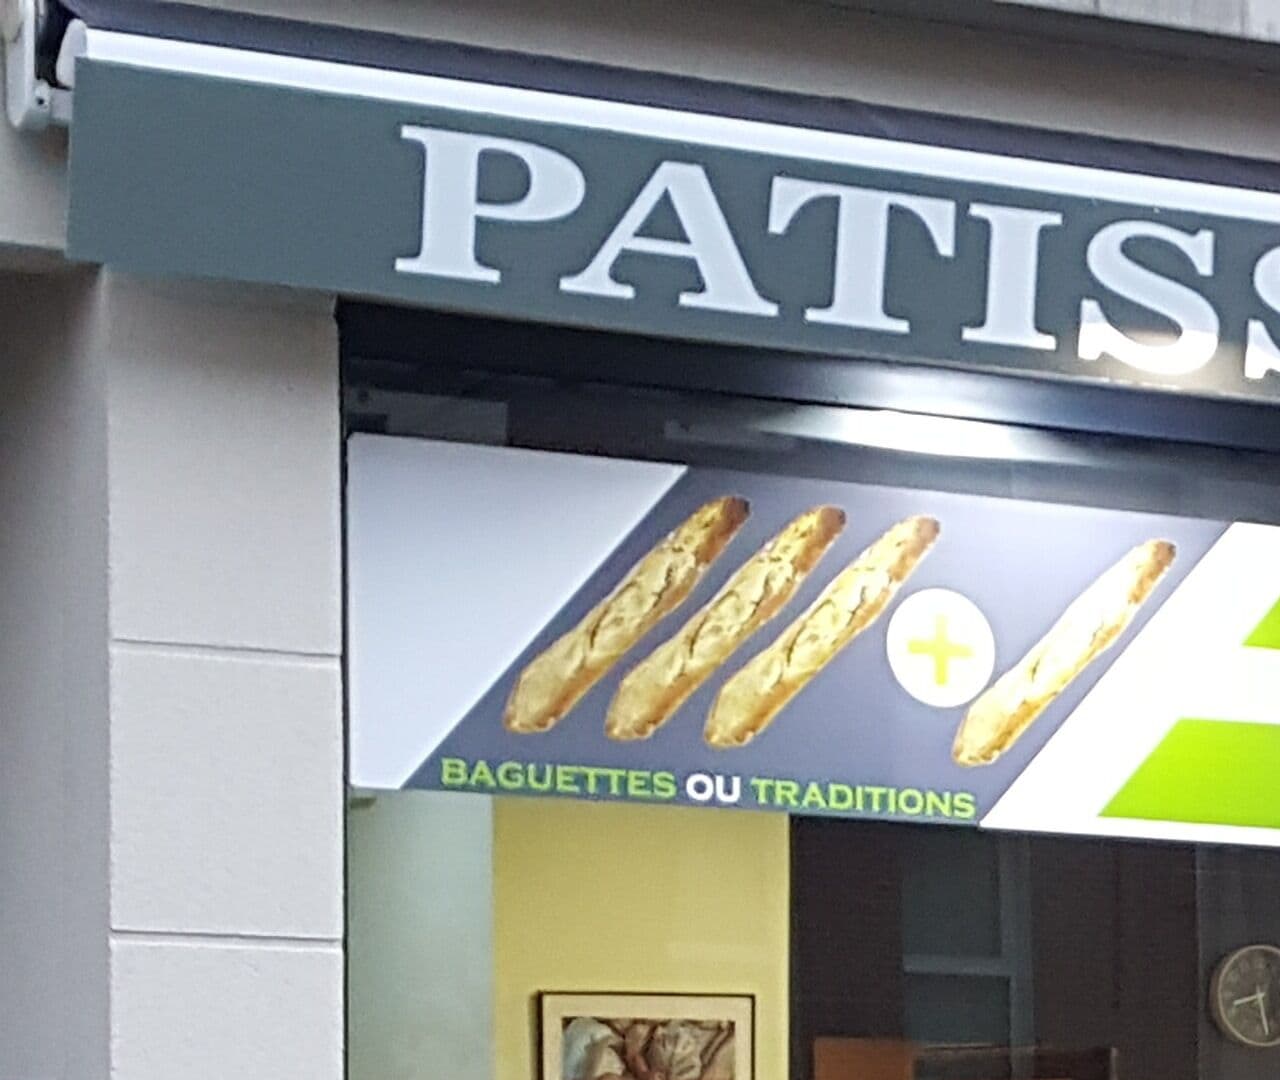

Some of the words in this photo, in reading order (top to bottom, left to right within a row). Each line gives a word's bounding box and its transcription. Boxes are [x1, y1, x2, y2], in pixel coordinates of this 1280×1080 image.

[441, 757, 676, 797] BAGUETTES
[686, 772, 741, 804] OU
[750, 777, 976, 818] TRADITIONS
